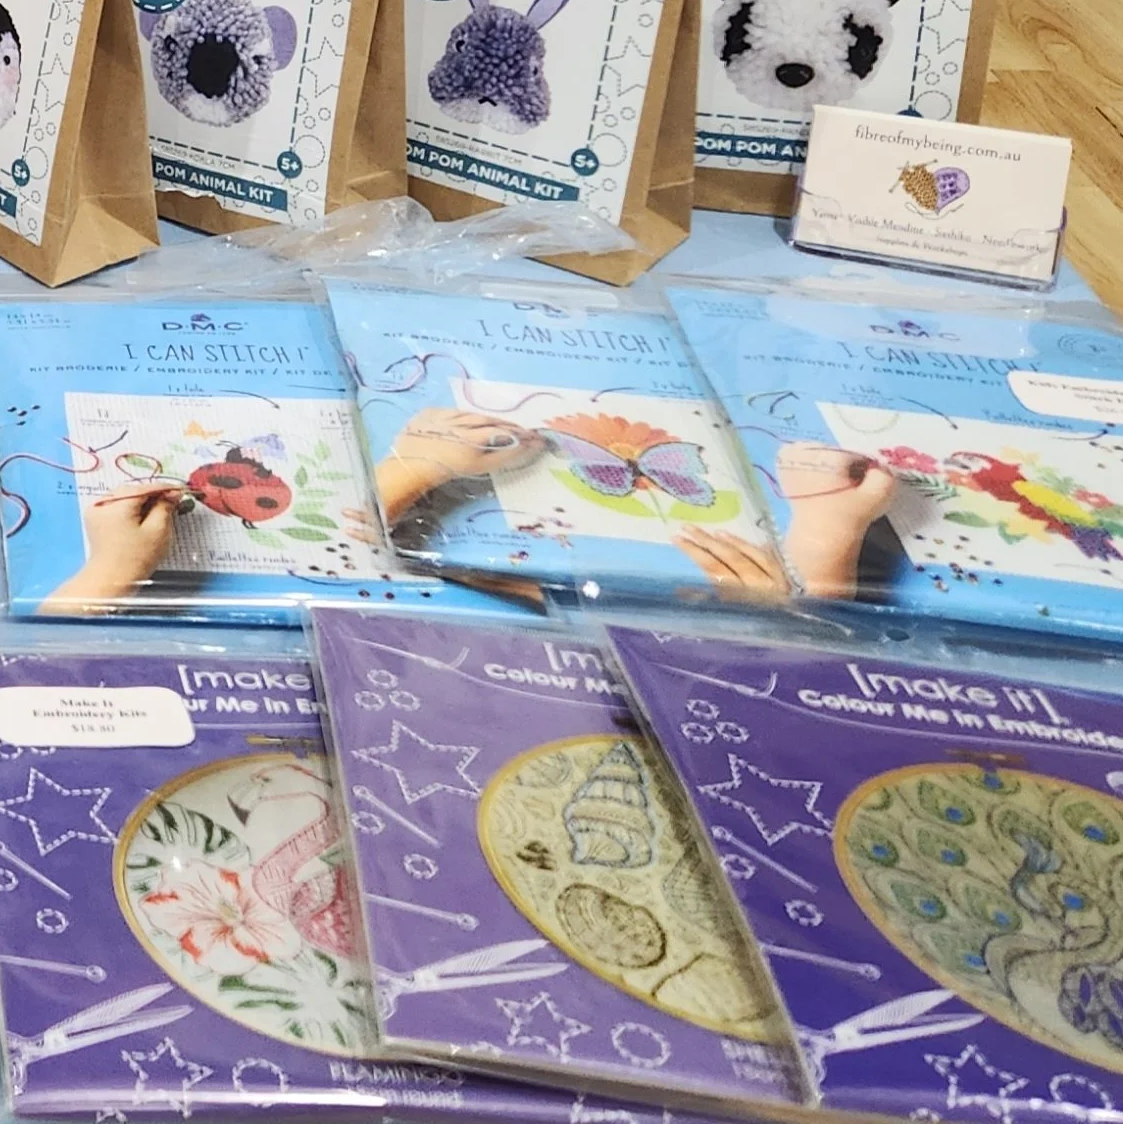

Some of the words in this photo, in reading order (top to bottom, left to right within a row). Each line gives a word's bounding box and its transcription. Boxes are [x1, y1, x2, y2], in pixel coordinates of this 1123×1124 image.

[855, 124, 1022, 163] fibreofmybeing.com.au
[281, 157, 299, 170] 5+
[575, 153, 595, 168] 5+
[155, 162, 186, 180] POM
[189, 170, 246, 198] ANIMAL
[249, 186, 274, 203] KIT
[478, 320, 489, 337] I
[501, 323, 552, 343] CAN
[562, 329, 650, 352] STITCH
[865, 344, 922, 365] CAN
[931, 351, 1022, 376] STITCH
[178, 665, 313, 695] [make
[483, 661, 580, 691] Colour
[584, 677, 626, 696] Me
[797, 688, 896, 717] Colour
[901, 702, 950, 725] Me
[953, 710, 983, 730] In
[989, 715, 1123, 751] Embroide
